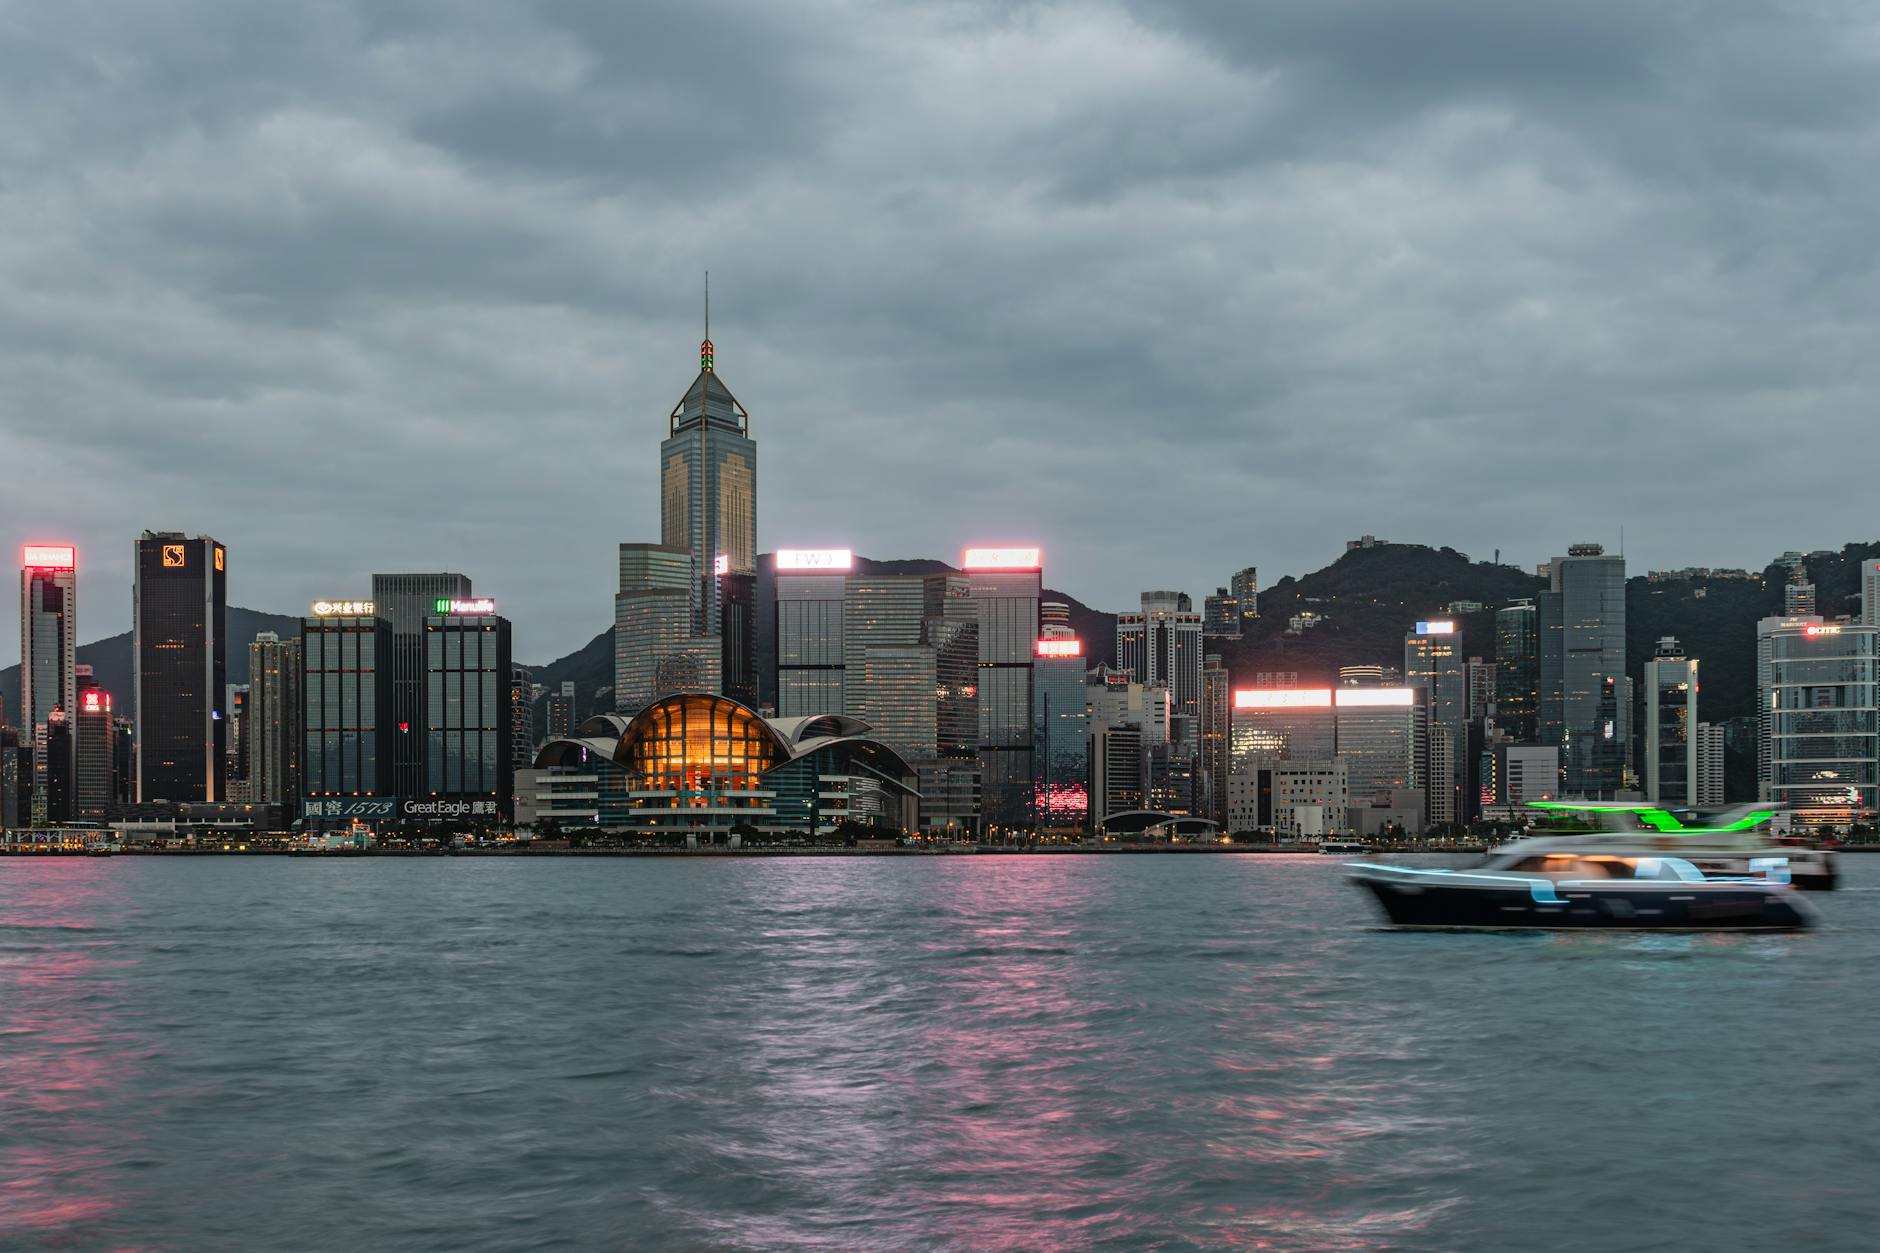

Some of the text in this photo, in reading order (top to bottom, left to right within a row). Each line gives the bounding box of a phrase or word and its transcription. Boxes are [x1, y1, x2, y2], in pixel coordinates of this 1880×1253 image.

[450, 599, 494, 612] Manulife
[1816, 626, 1840, 634] CITIC
[344, 801, 393, 814] 1573
[404, 800, 497, 816] Great Eagle 鷹君
